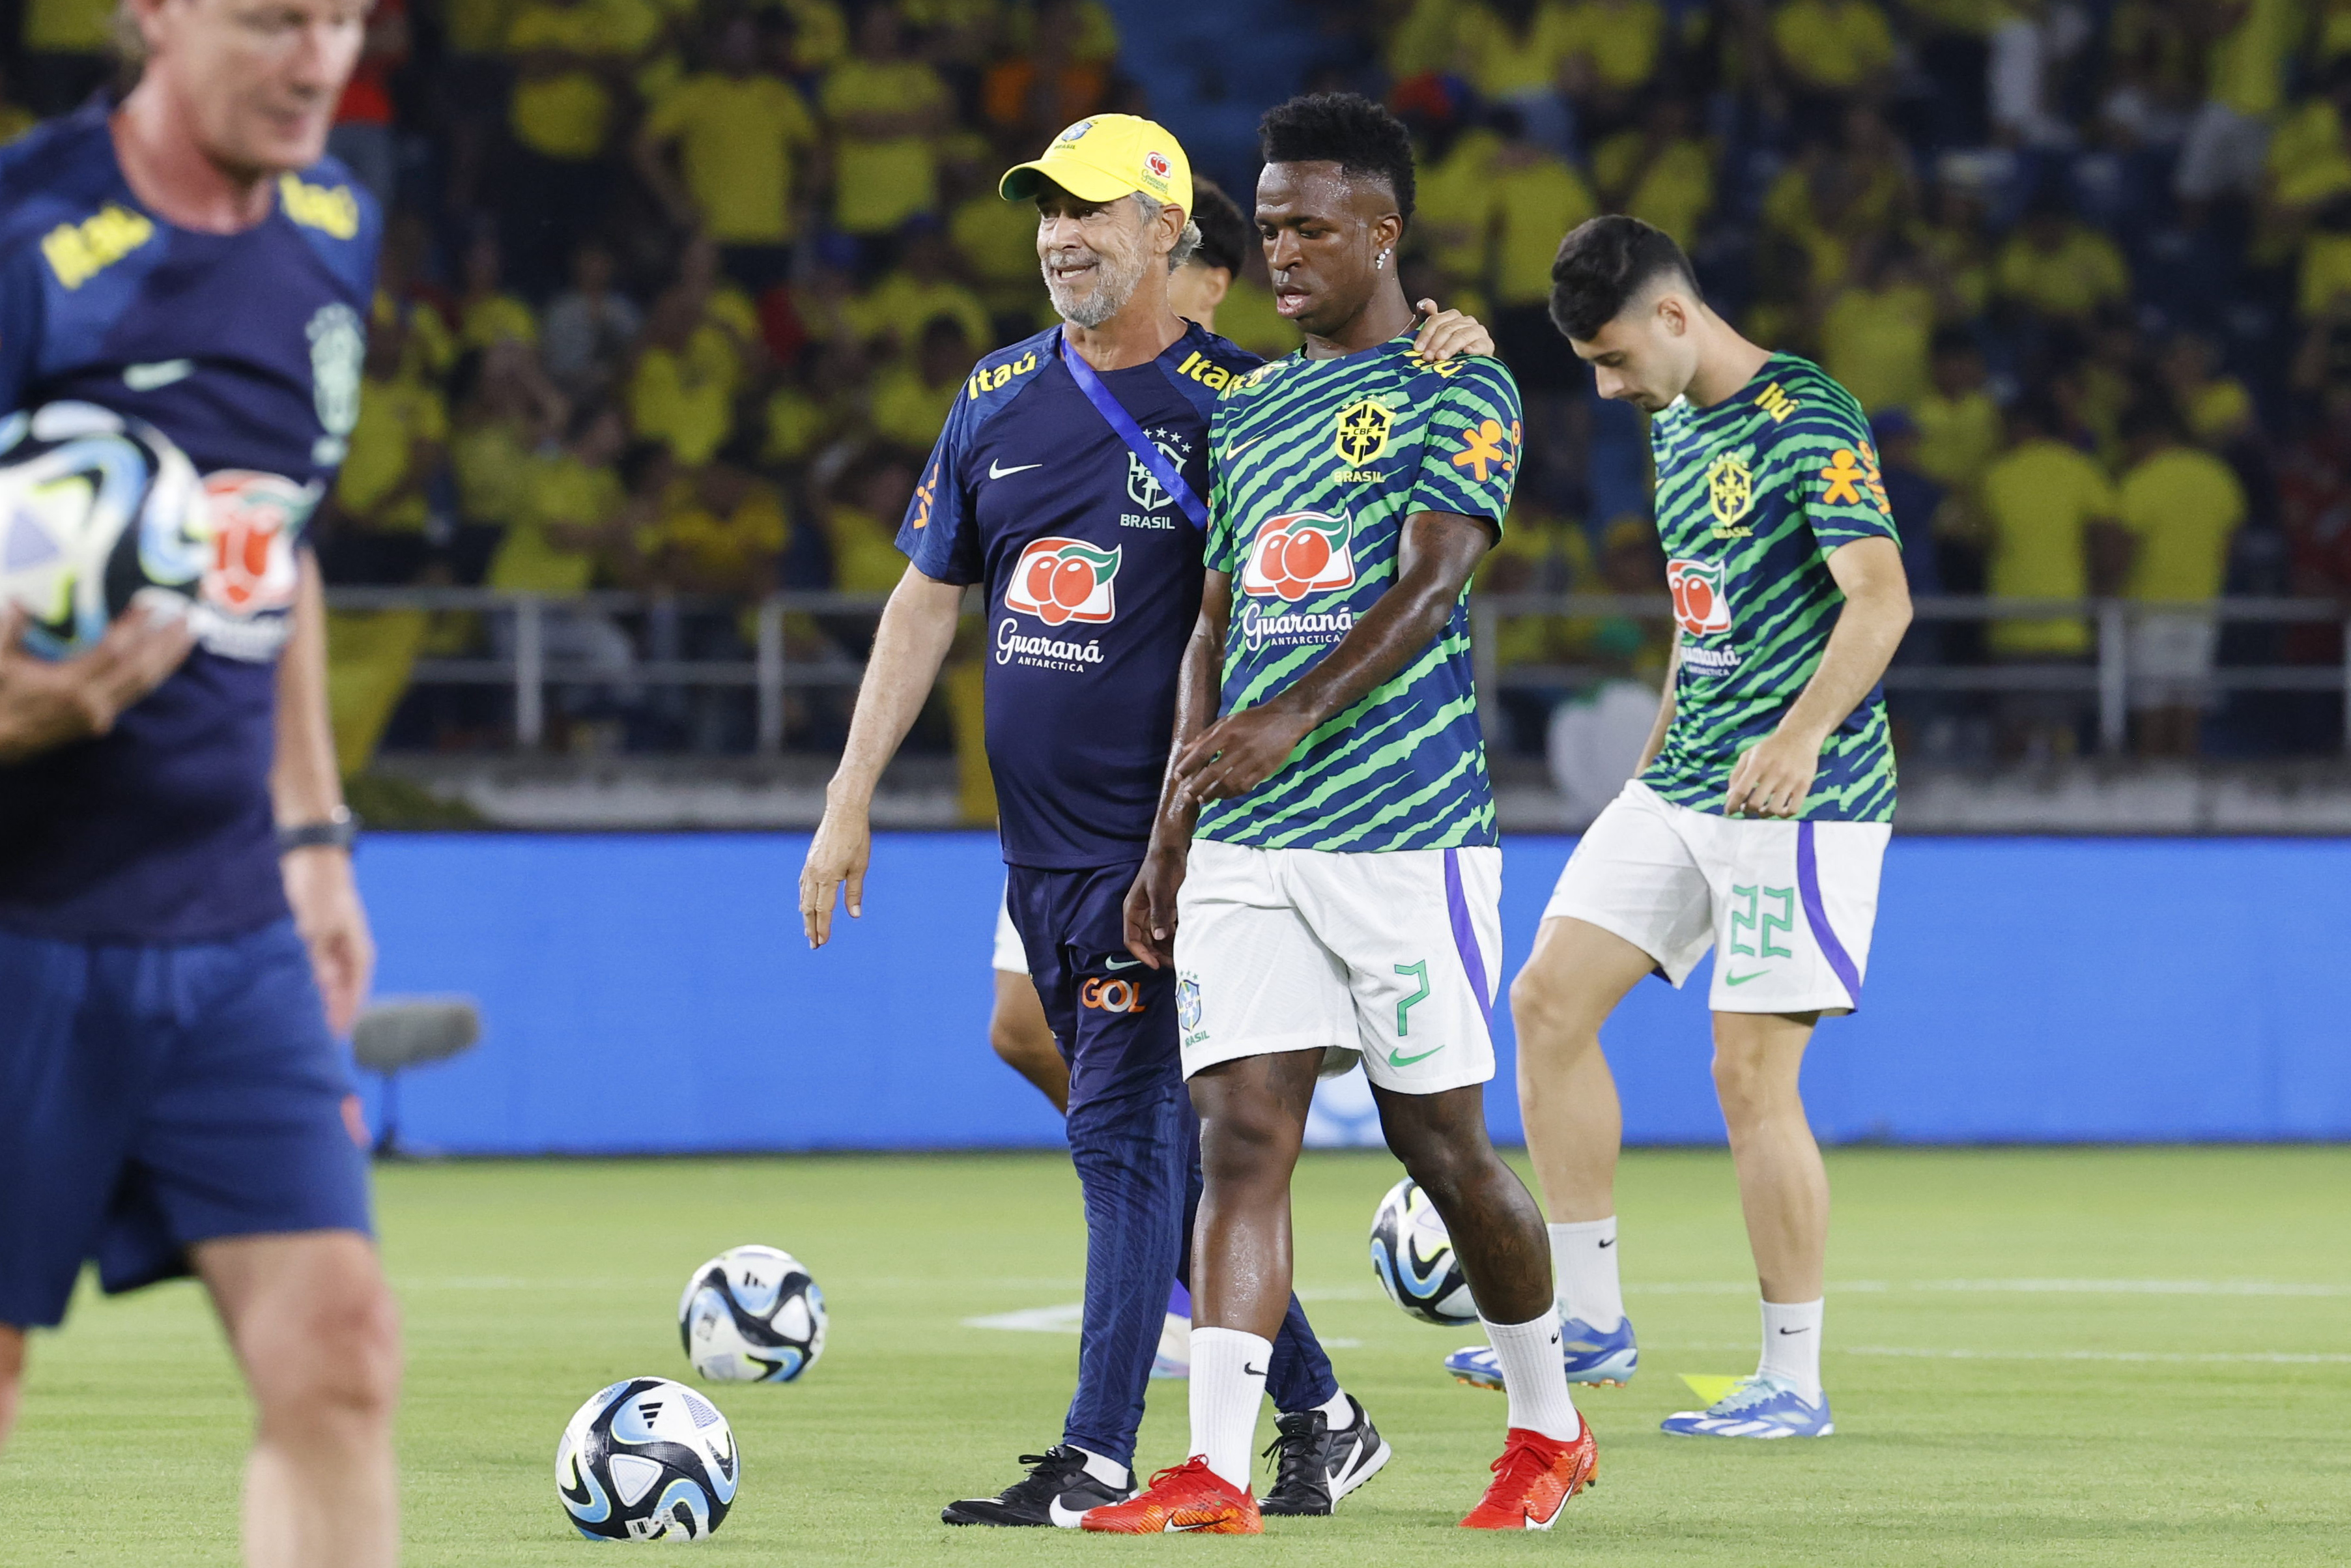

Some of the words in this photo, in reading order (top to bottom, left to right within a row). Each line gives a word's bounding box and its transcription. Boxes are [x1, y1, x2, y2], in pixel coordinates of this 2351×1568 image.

[969, 350, 1036, 400] Itaú
[1176, 350, 1231, 392] Ita
[1333, 470, 1385, 483] BRASIL
[1120, 513, 1175, 530] BRASIL
[995, 618, 1105, 665] Guaraná
[1244, 603, 1357, 651] Guaraná
[1271, 634, 1341, 646] ANTARCTICA
[1018, 656, 1085, 673] ANTARCTICA
[1730, 884, 1794, 959] 22
[1081, 977, 1147, 1013] GOL
[1394, 959, 1431, 1037] 7
